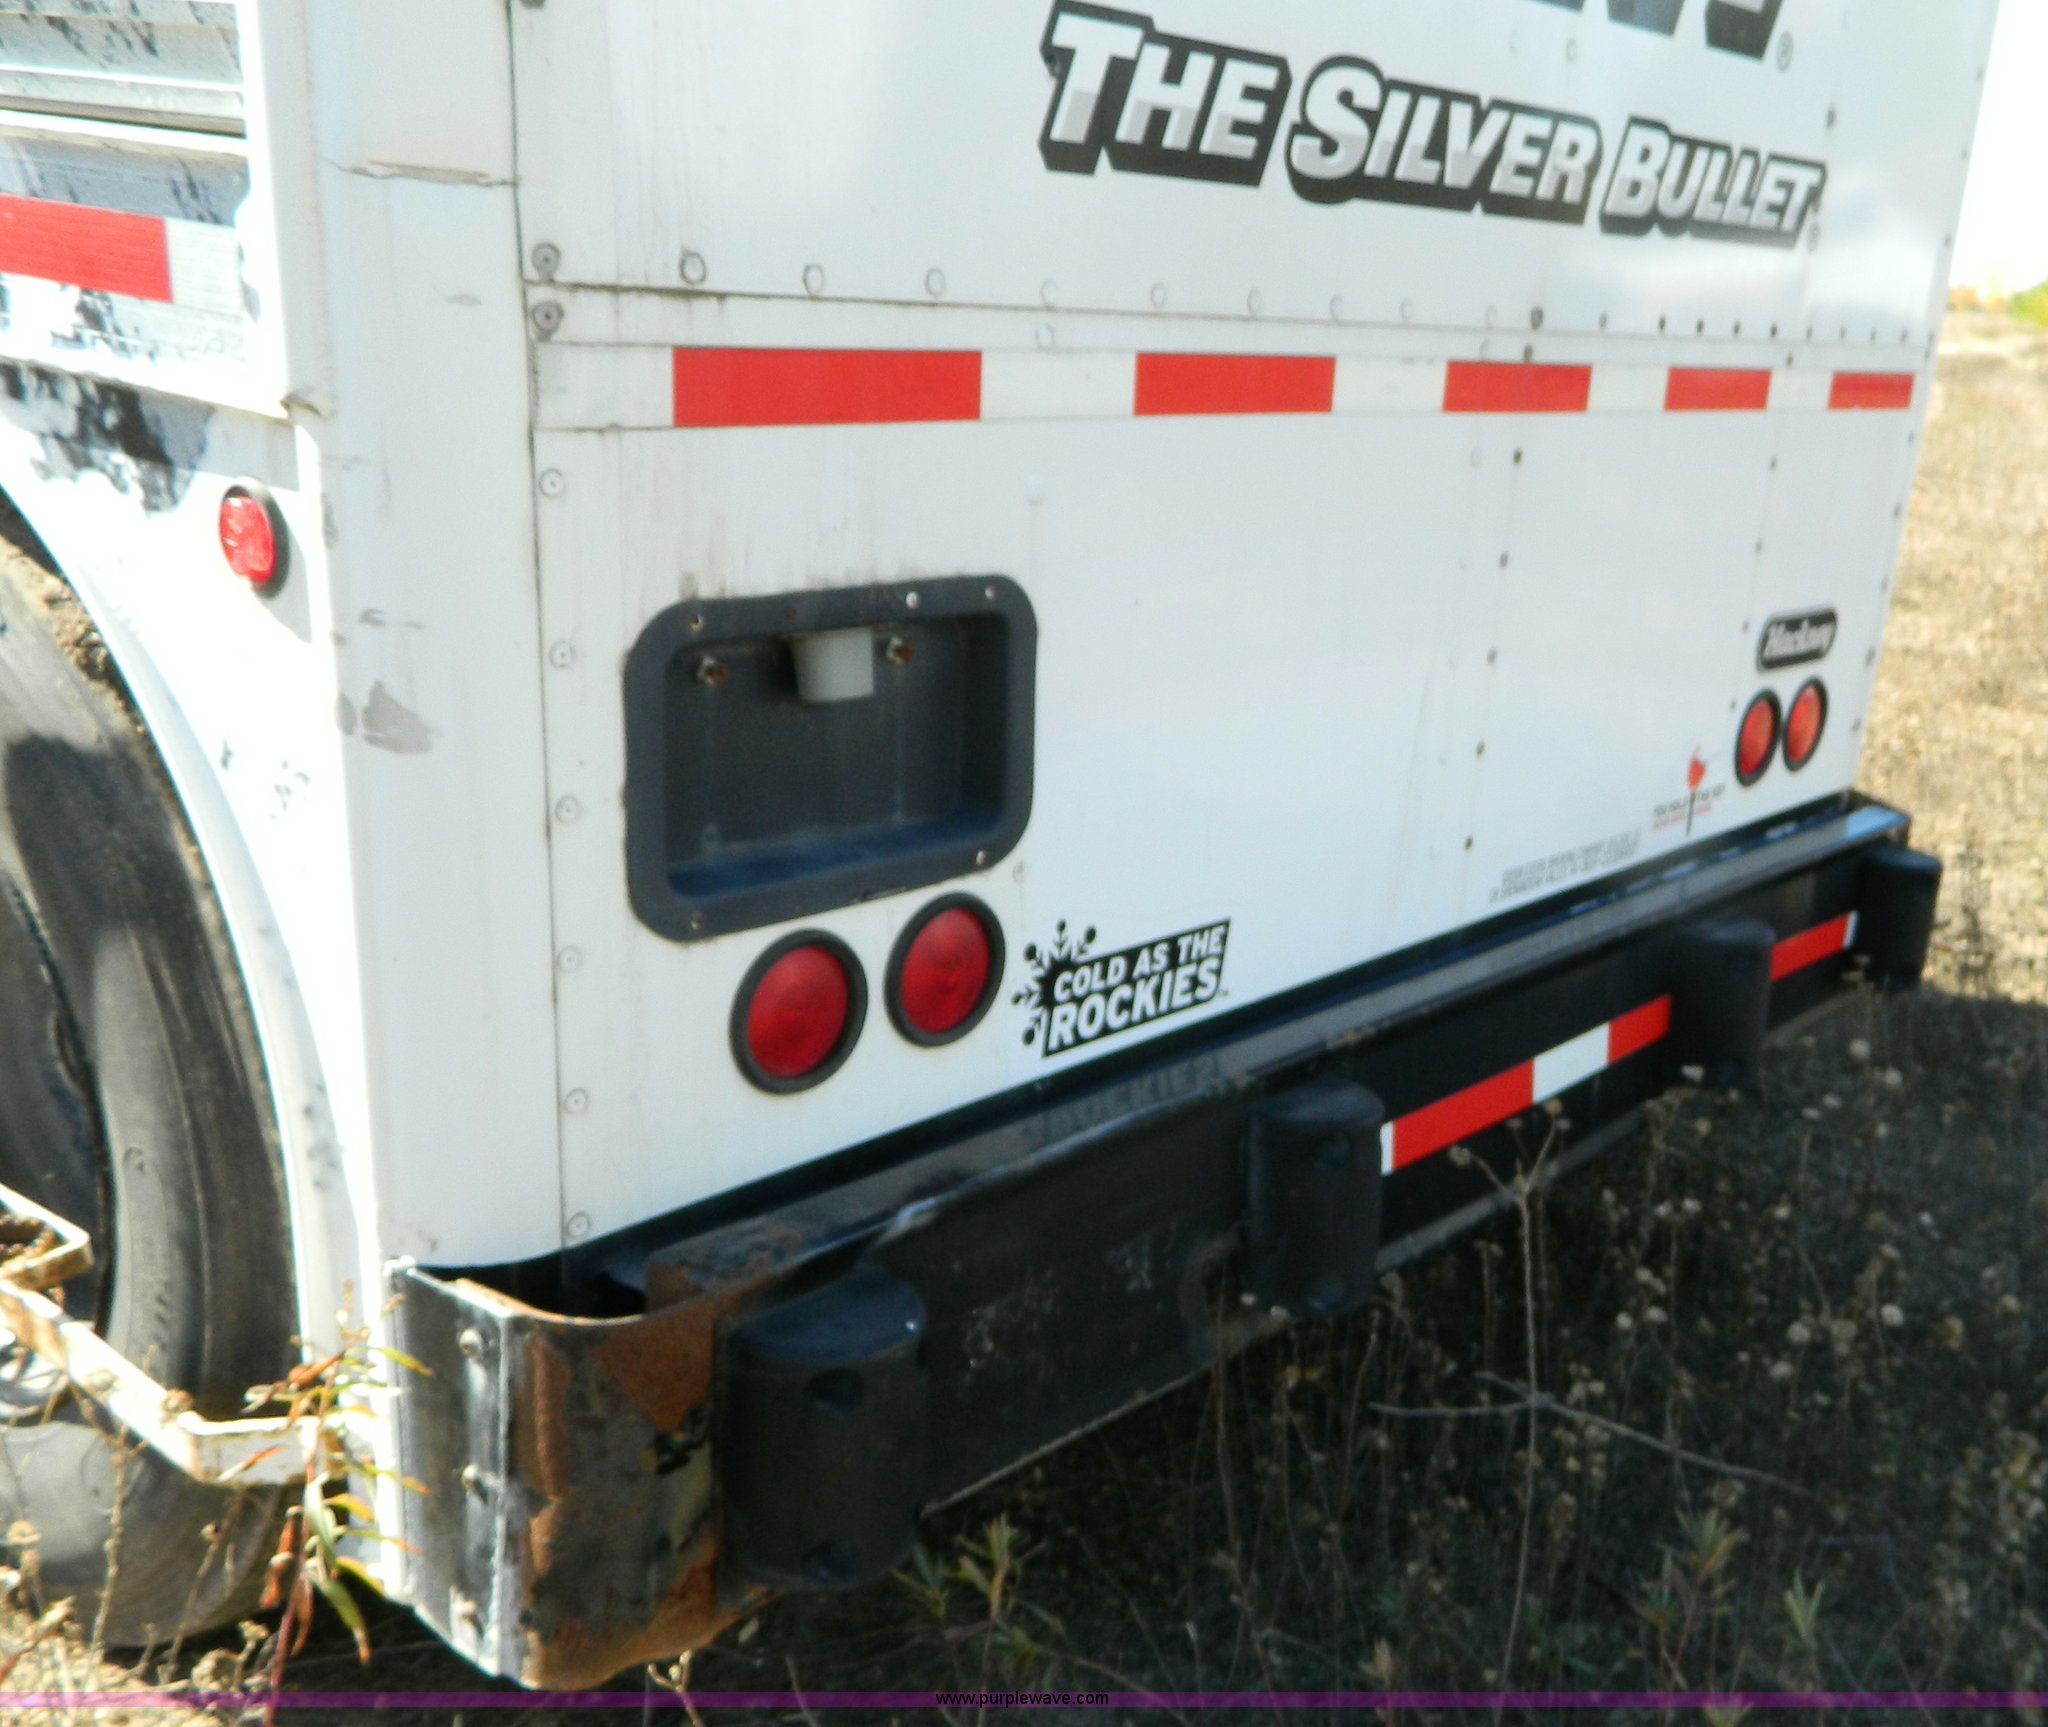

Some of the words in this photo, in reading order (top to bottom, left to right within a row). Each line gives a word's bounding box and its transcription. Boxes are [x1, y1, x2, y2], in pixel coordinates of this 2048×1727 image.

[1045, 6, 1286, 174] THE
[1289, 60, 1598, 214] SILVER
[1602, 118, 1824, 240] BULLET
[1049, 957, 1220, 1050] ROCKIES
[1053, 955, 1127, 1002] COLD
[1131, 941, 1170, 980] AS
[1177, 924, 1227, 964] THE
